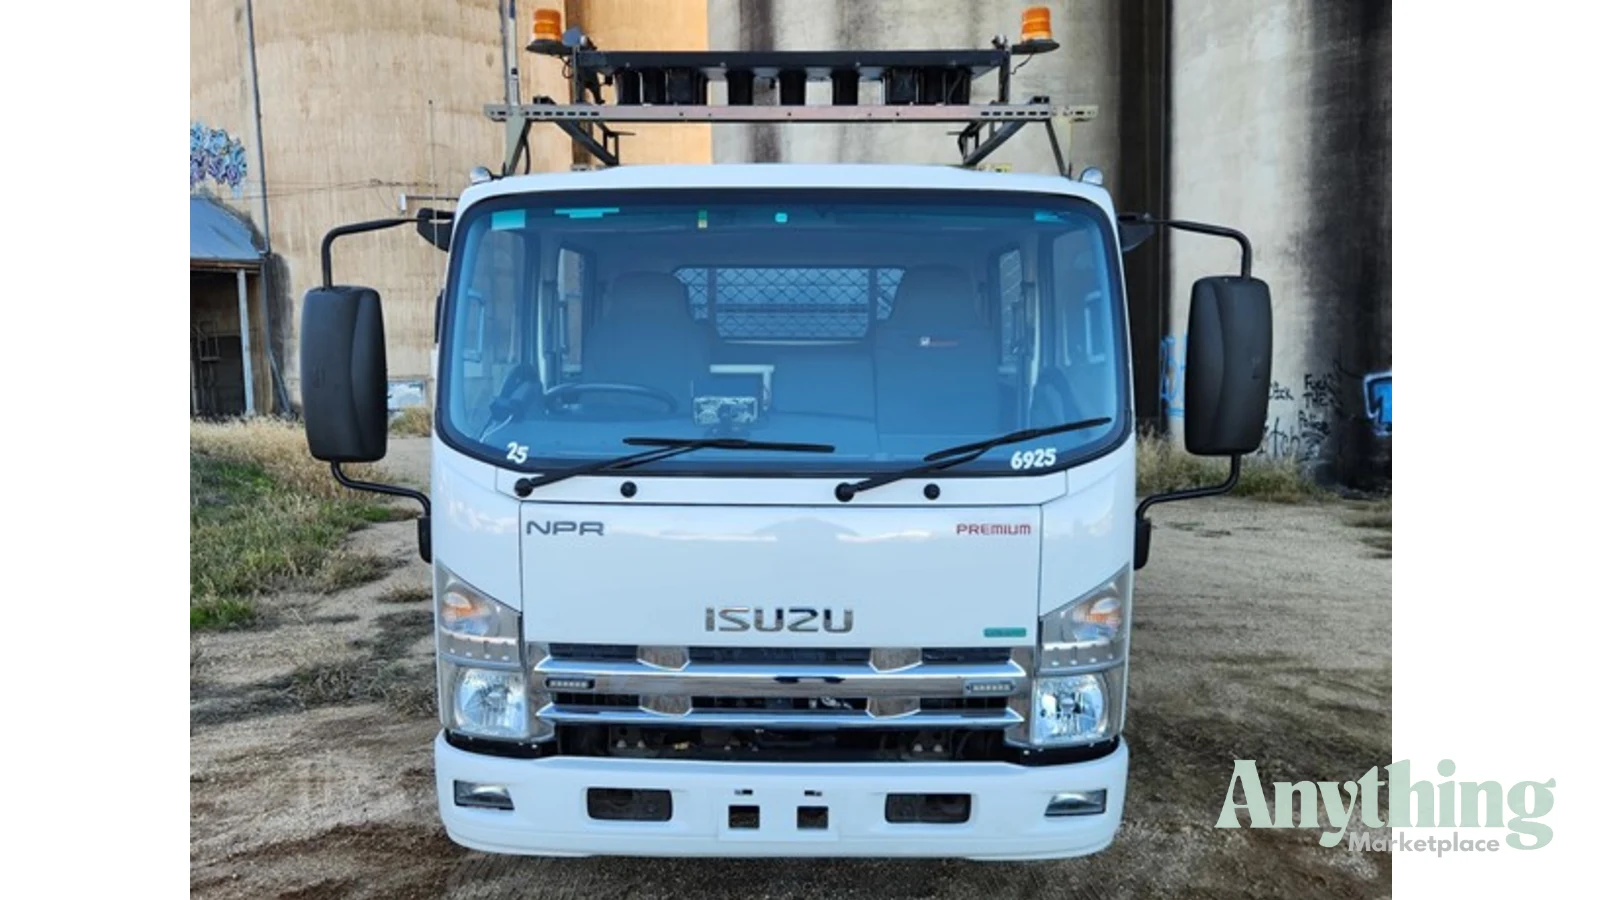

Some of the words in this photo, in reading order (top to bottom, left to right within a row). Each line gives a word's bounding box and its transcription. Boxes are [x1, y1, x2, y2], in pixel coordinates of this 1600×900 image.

[506, 440, 529, 464] 25
[1010, 447, 1057, 470] 6925
[526, 520, 605, 536] NPR
[956, 523, 1032, 536] PREMIUM
[704, 606, 854, 634] ISUZU
